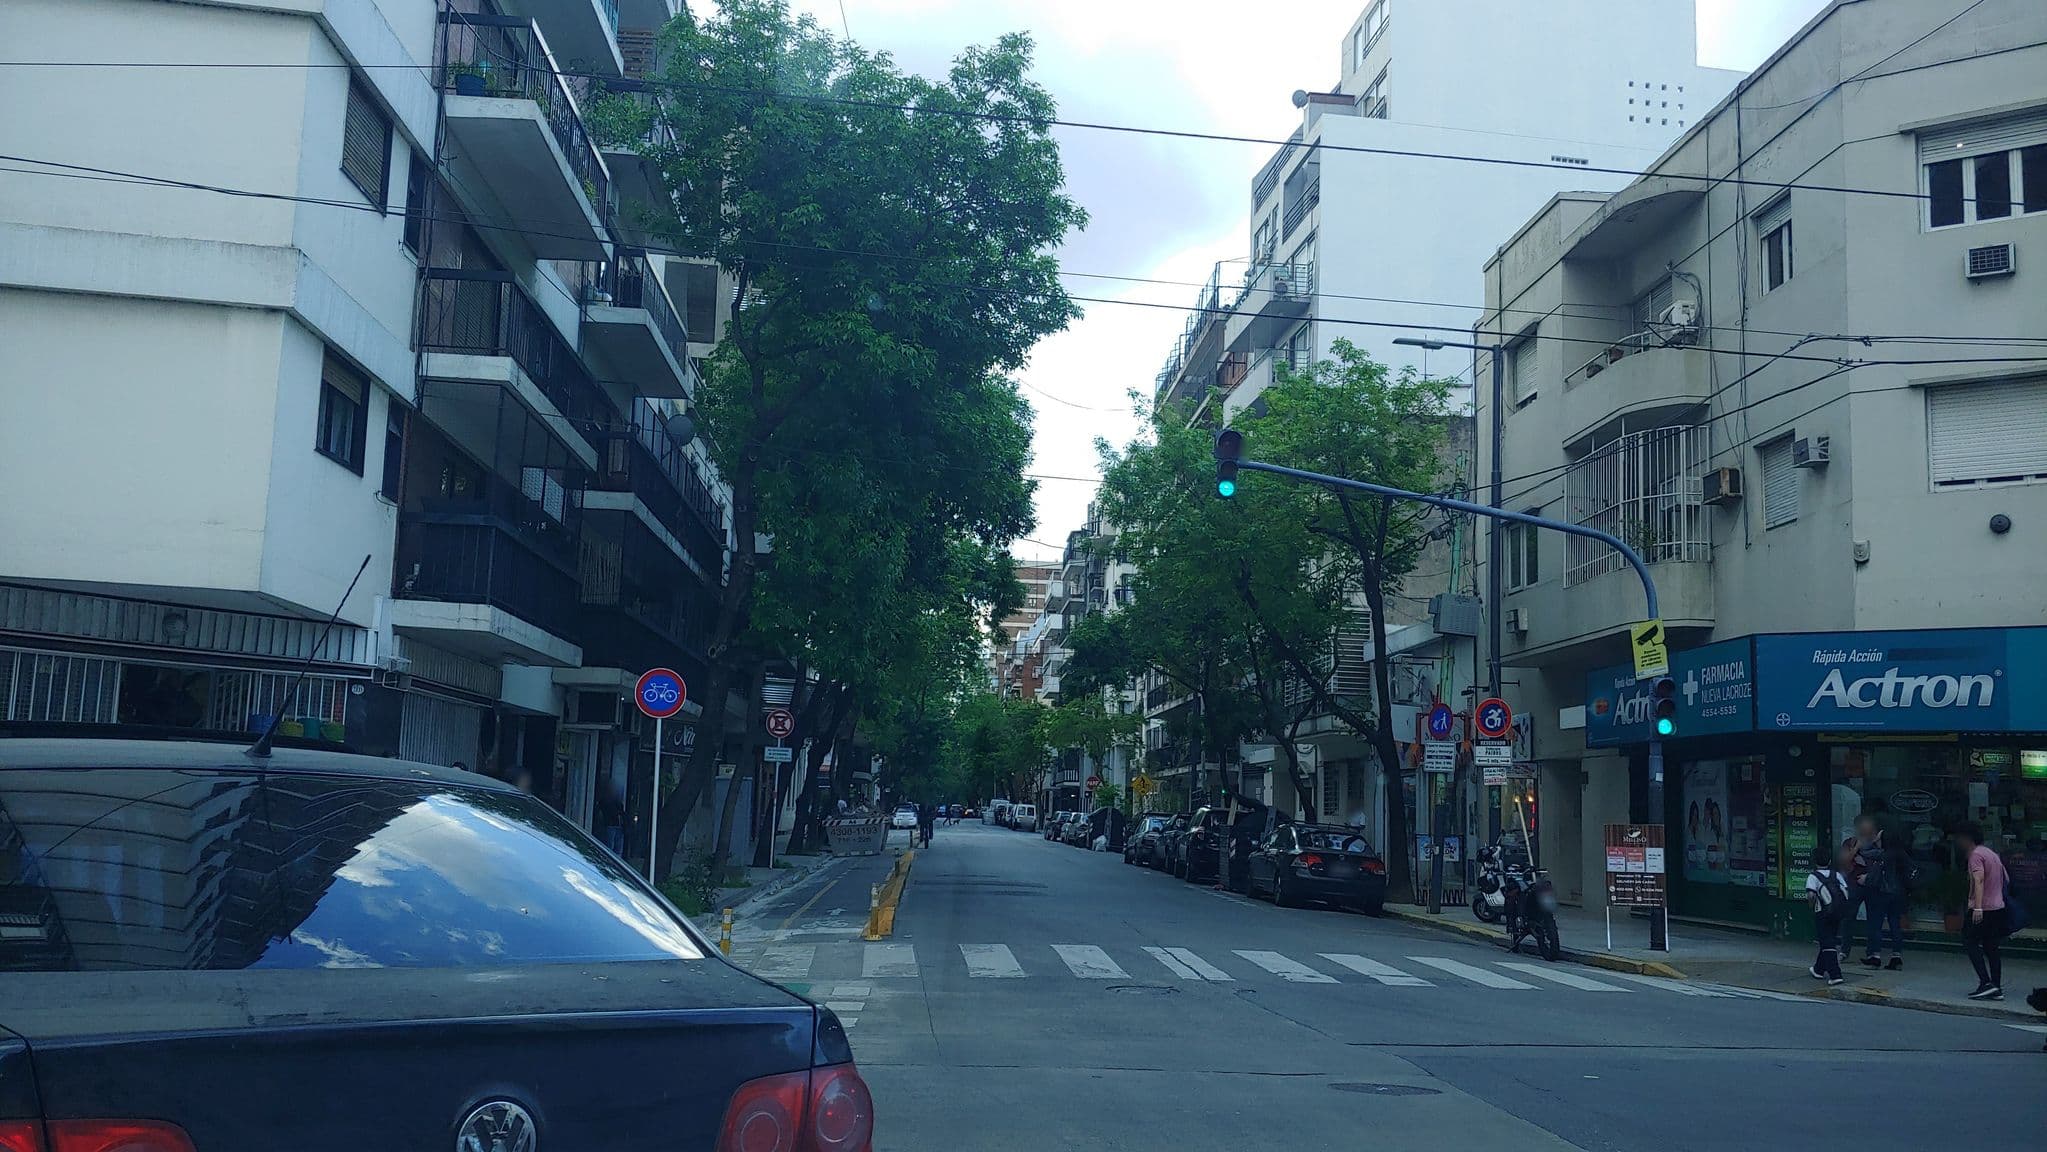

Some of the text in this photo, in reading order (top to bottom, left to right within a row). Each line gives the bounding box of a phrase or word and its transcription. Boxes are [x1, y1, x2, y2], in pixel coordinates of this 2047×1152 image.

[1813, 648, 1883, 666] Rápida Acción
[1701, 661, 1745, 685] FARMACIA
[1702, 682, 1752, 704] NUEVA LACROZE
[1806, 667, 1995, 708] Actron
[1613, 690, 1651, 726] Actr
